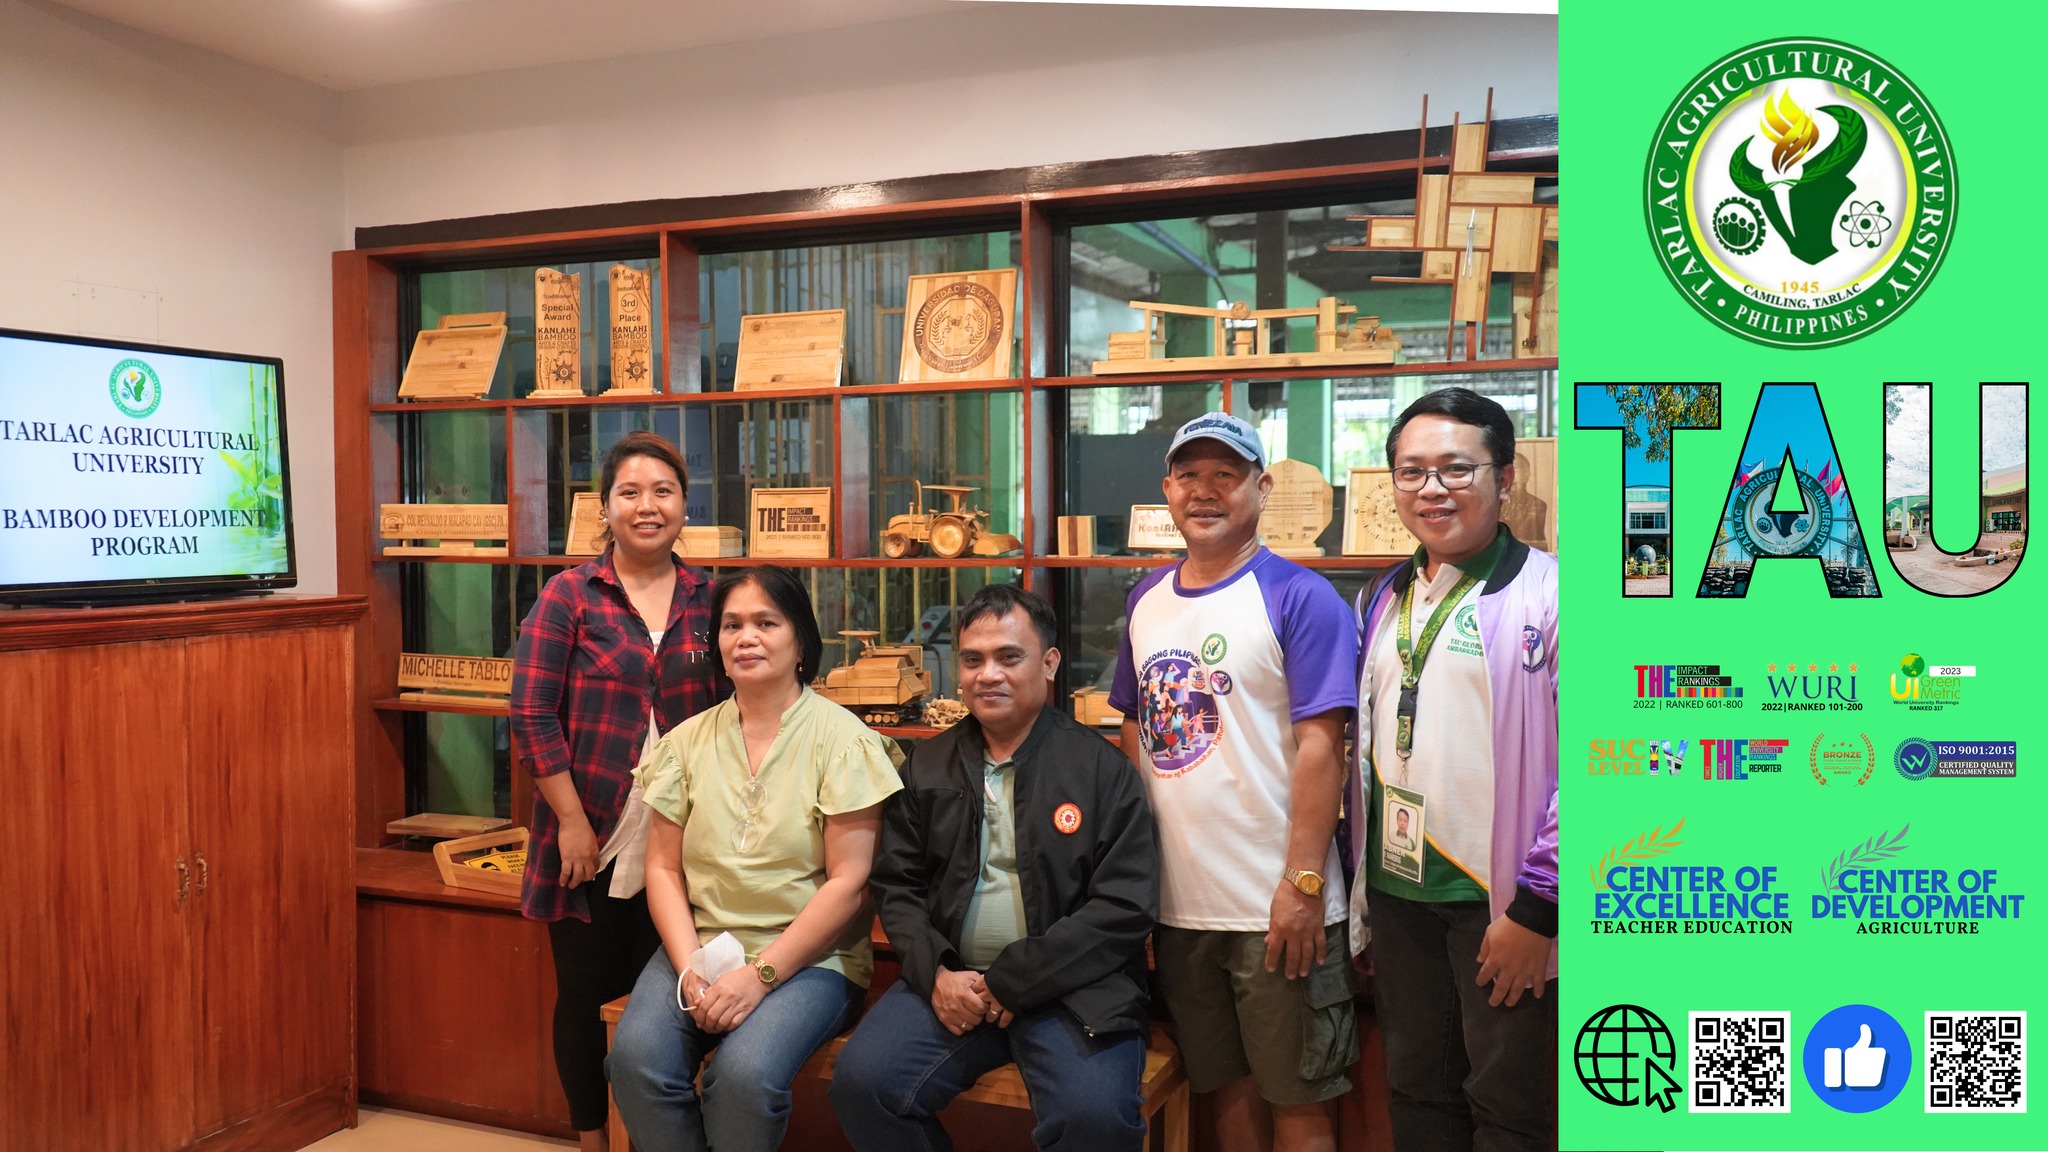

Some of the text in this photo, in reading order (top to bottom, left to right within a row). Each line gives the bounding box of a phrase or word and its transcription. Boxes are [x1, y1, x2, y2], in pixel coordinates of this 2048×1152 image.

[542, 304, 574, 312] Special
[622, 299, 636, 307] 3rd
[916, 285, 1001, 337] UNIVERSIDAD DE DAGUPAN
[544, 313, 571, 321] Award
[613, 325, 647, 333] KANLAHI
[0, 420, 260, 451] TARLAC AGRICULTURAL
[72, 453, 205, 475] UNIVERSITY
[3, 509, 267, 529] BAMBOO DEVELOPMENT
[758, 507, 786, 532] THE
[1734, 509, 1752, 552] TARLAC
[1814, 489, 1831, 549] UNIVERSITY
[91, 536, 199, 556] PROGRAM
[1447, 645, 1484, 657] AMBASSADO
[402, 657, 511, 682] MICHELLE TABLO
